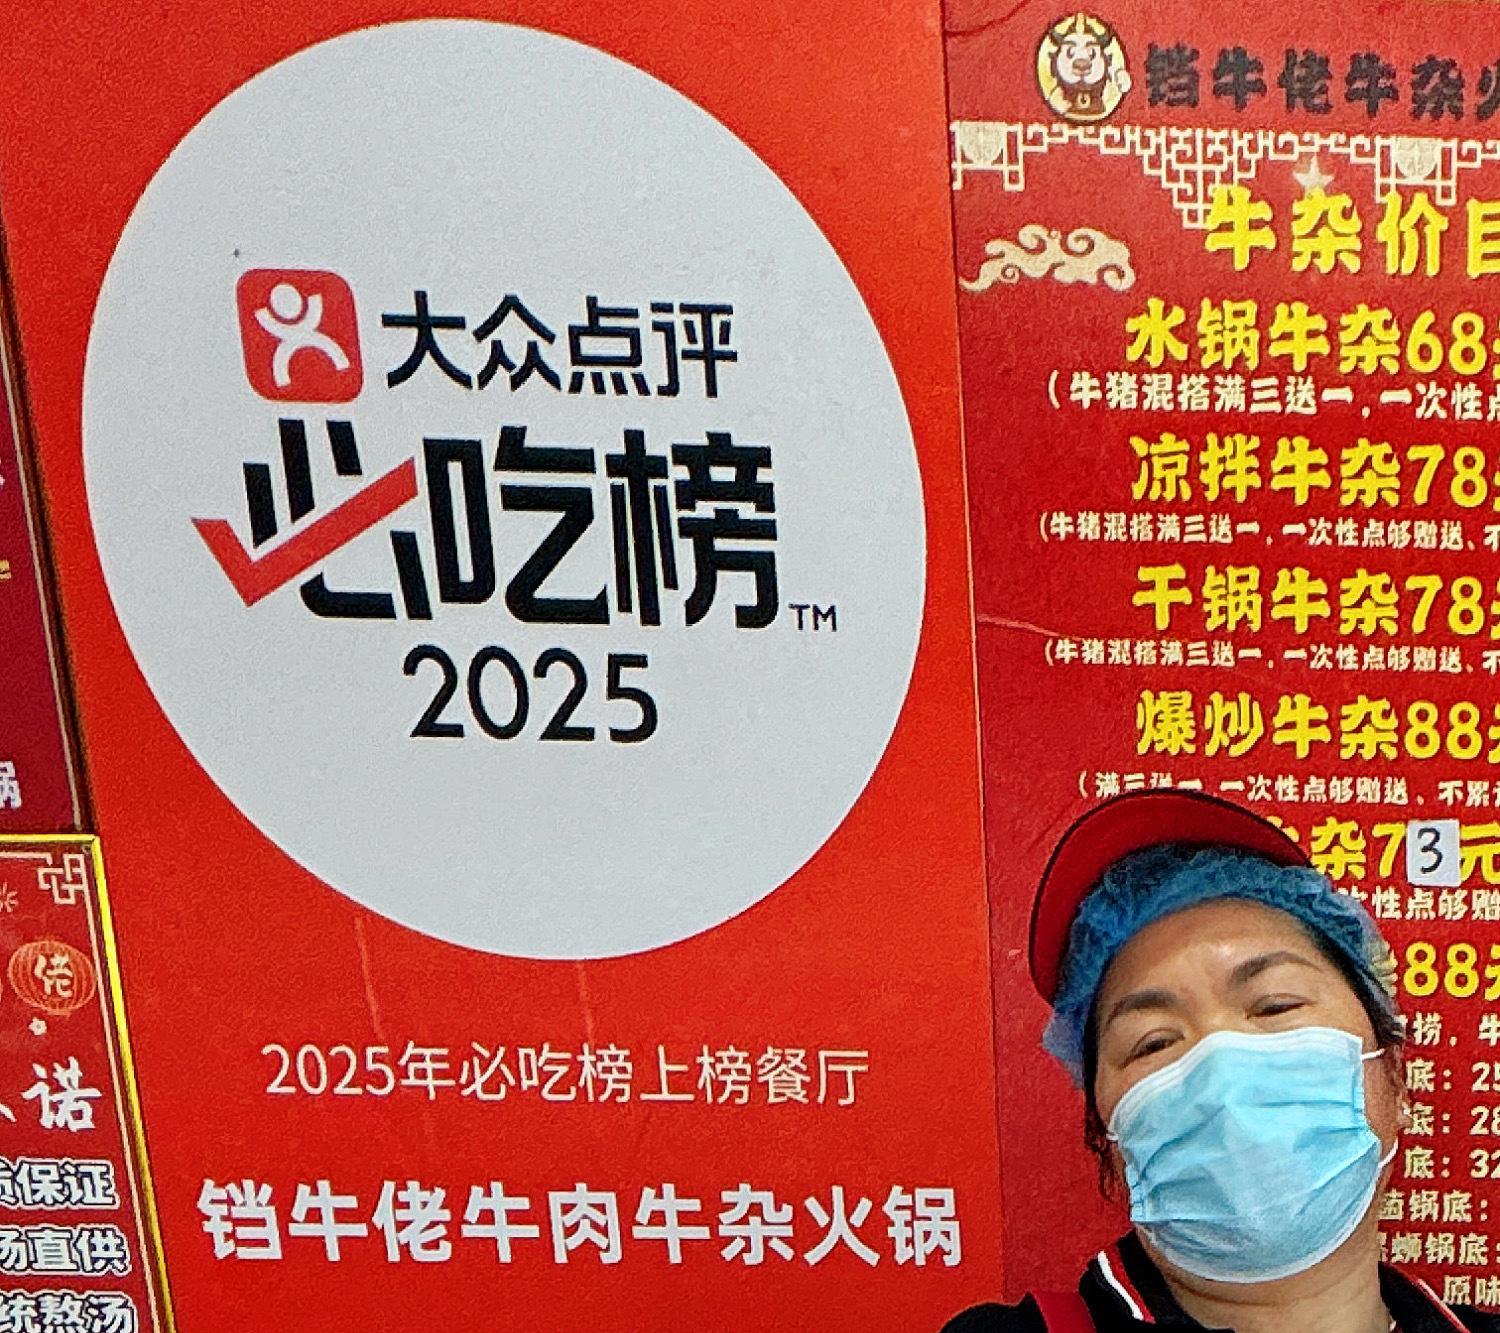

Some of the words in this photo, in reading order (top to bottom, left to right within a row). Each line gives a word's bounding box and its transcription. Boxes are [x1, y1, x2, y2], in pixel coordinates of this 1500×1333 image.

[381, 289, 738, 398] 大众点评
[190, 418, 780, 630] 必吃榜
[402, 645, 658, 742] 2025
[34, 954, 73, 998] 佬
[0, 1055, 102, 1132] 诺
[260, 1041, 870, 1107] 2025年必吃榜上榜餐厅
[196, 1177, 963, 1269] 铛牛佬牛肉牛杂火锅
